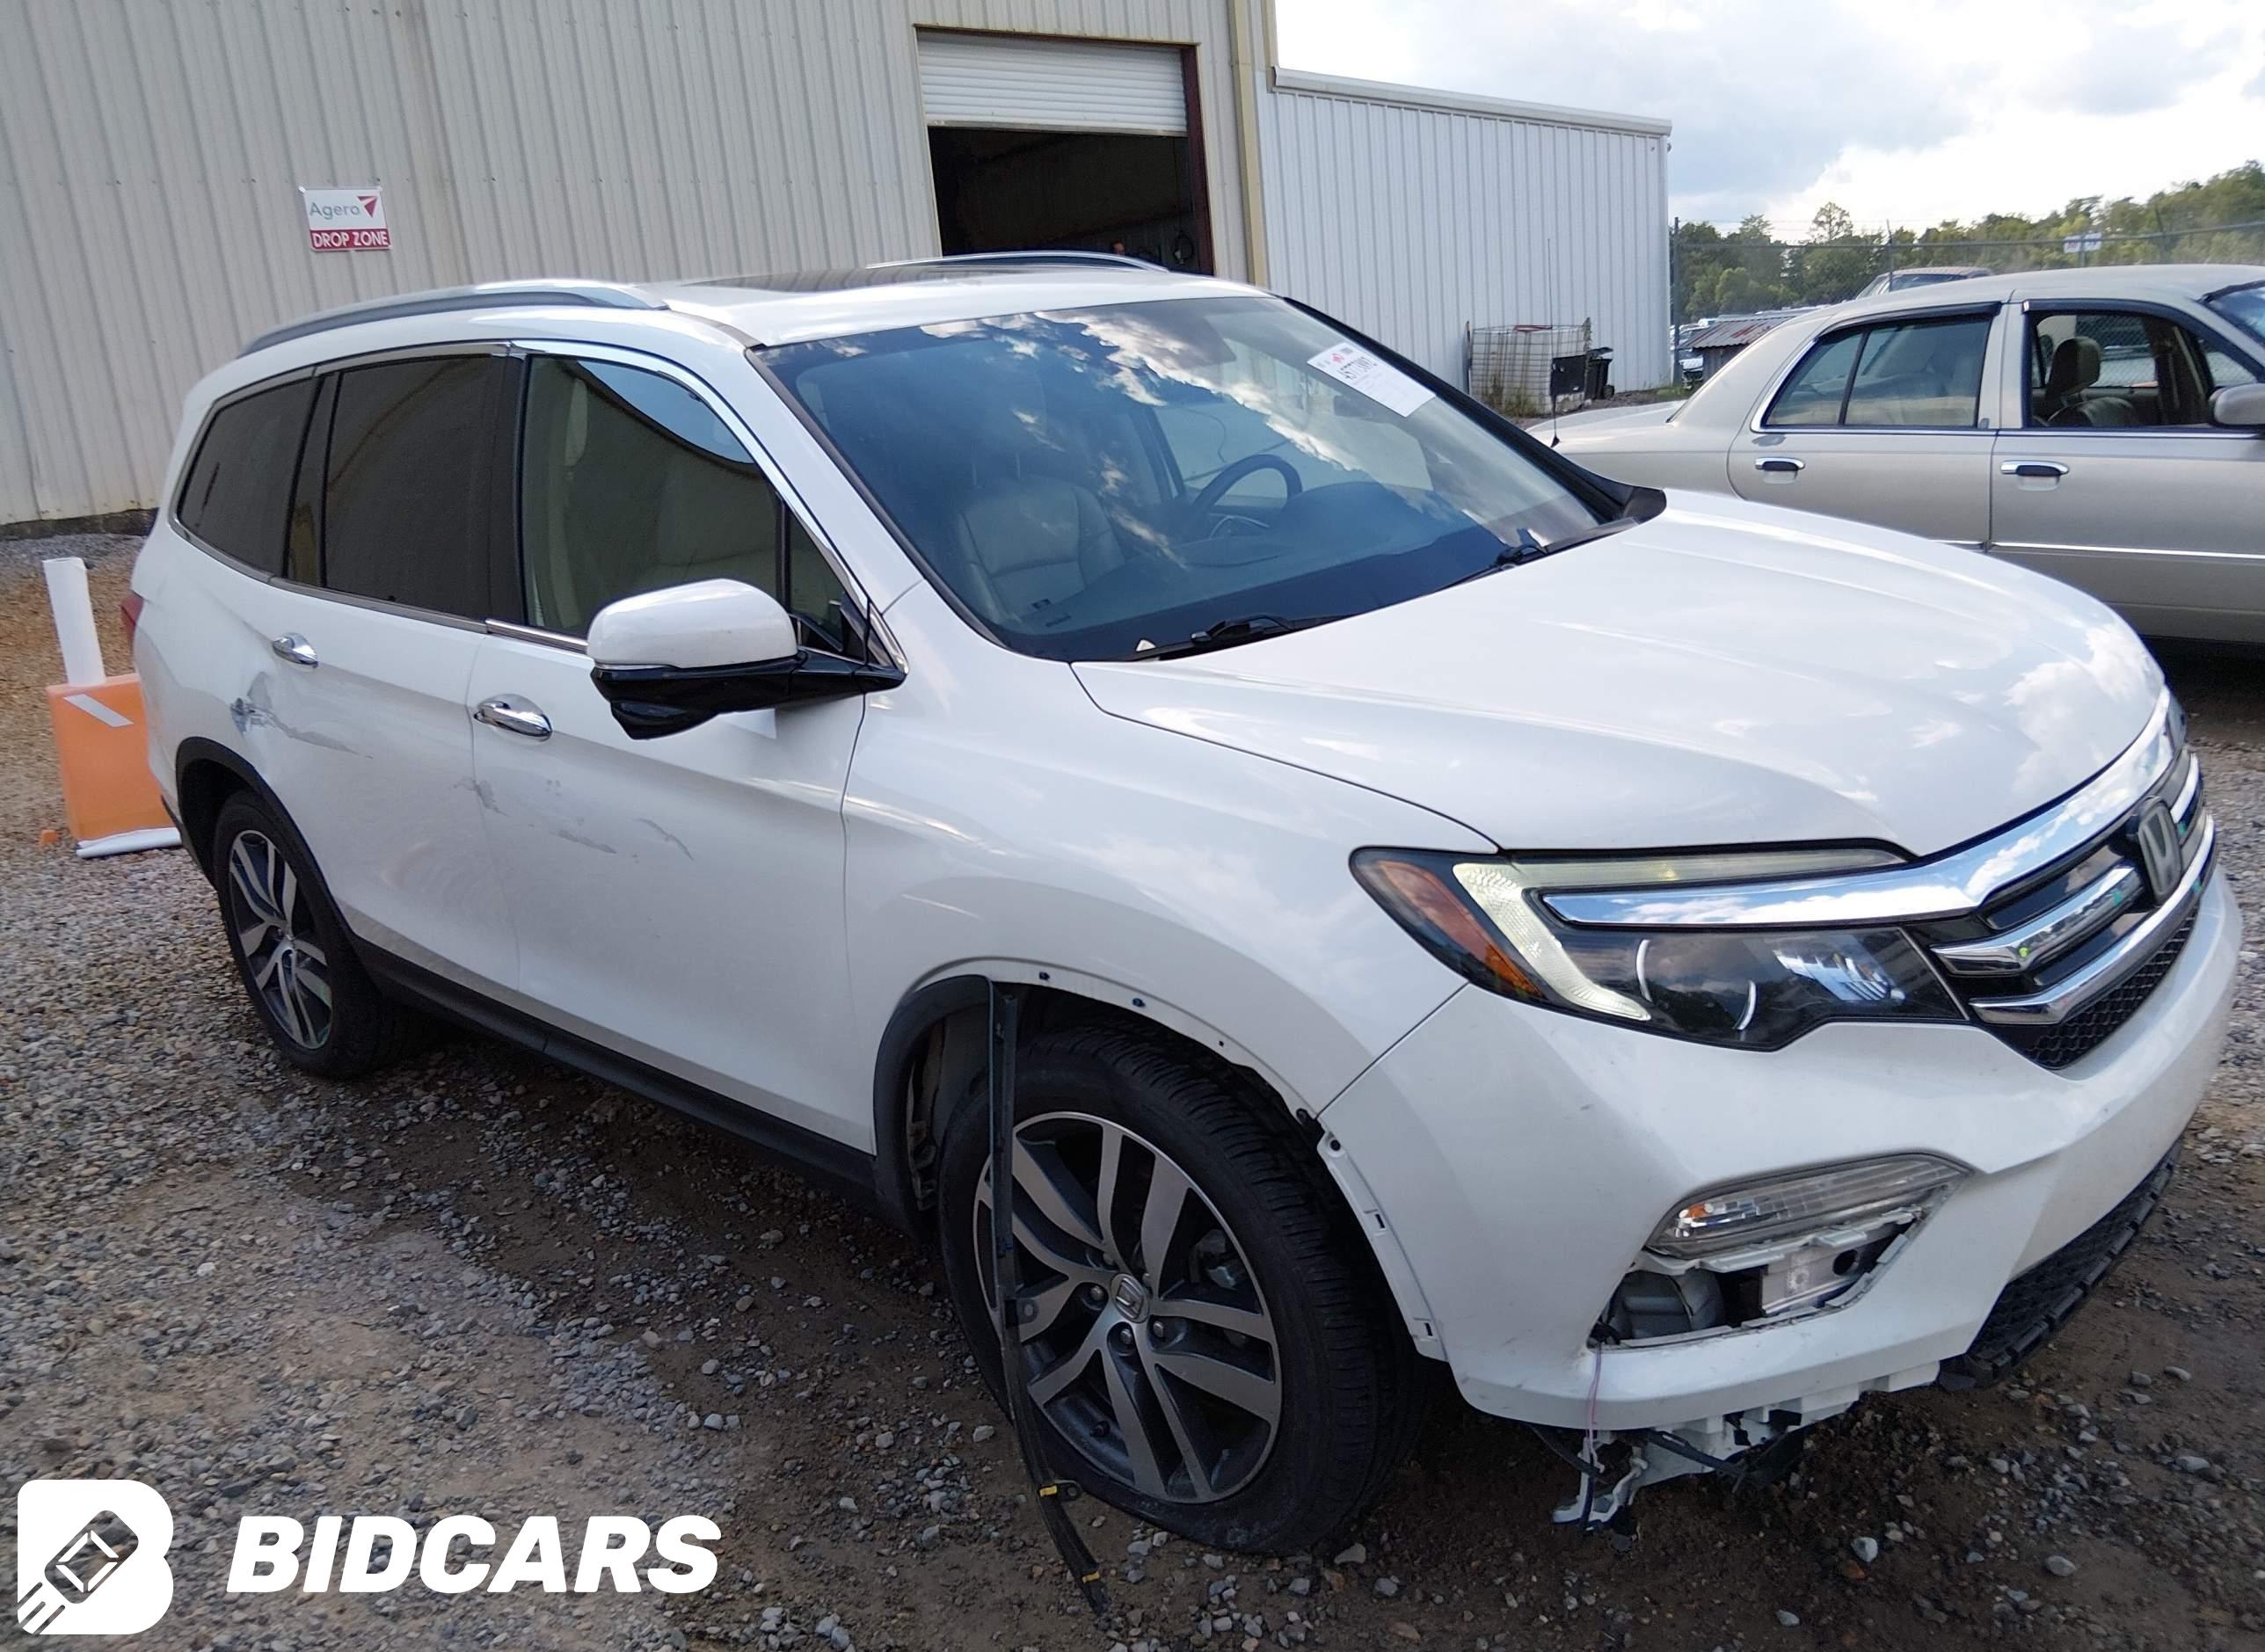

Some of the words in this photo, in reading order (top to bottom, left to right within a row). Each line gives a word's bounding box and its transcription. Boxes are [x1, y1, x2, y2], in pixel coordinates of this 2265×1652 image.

[310, 202, 361, 220] Agero
[312, 232, 350, 247] DROP
[352, 231, 389, 246] ZONE
